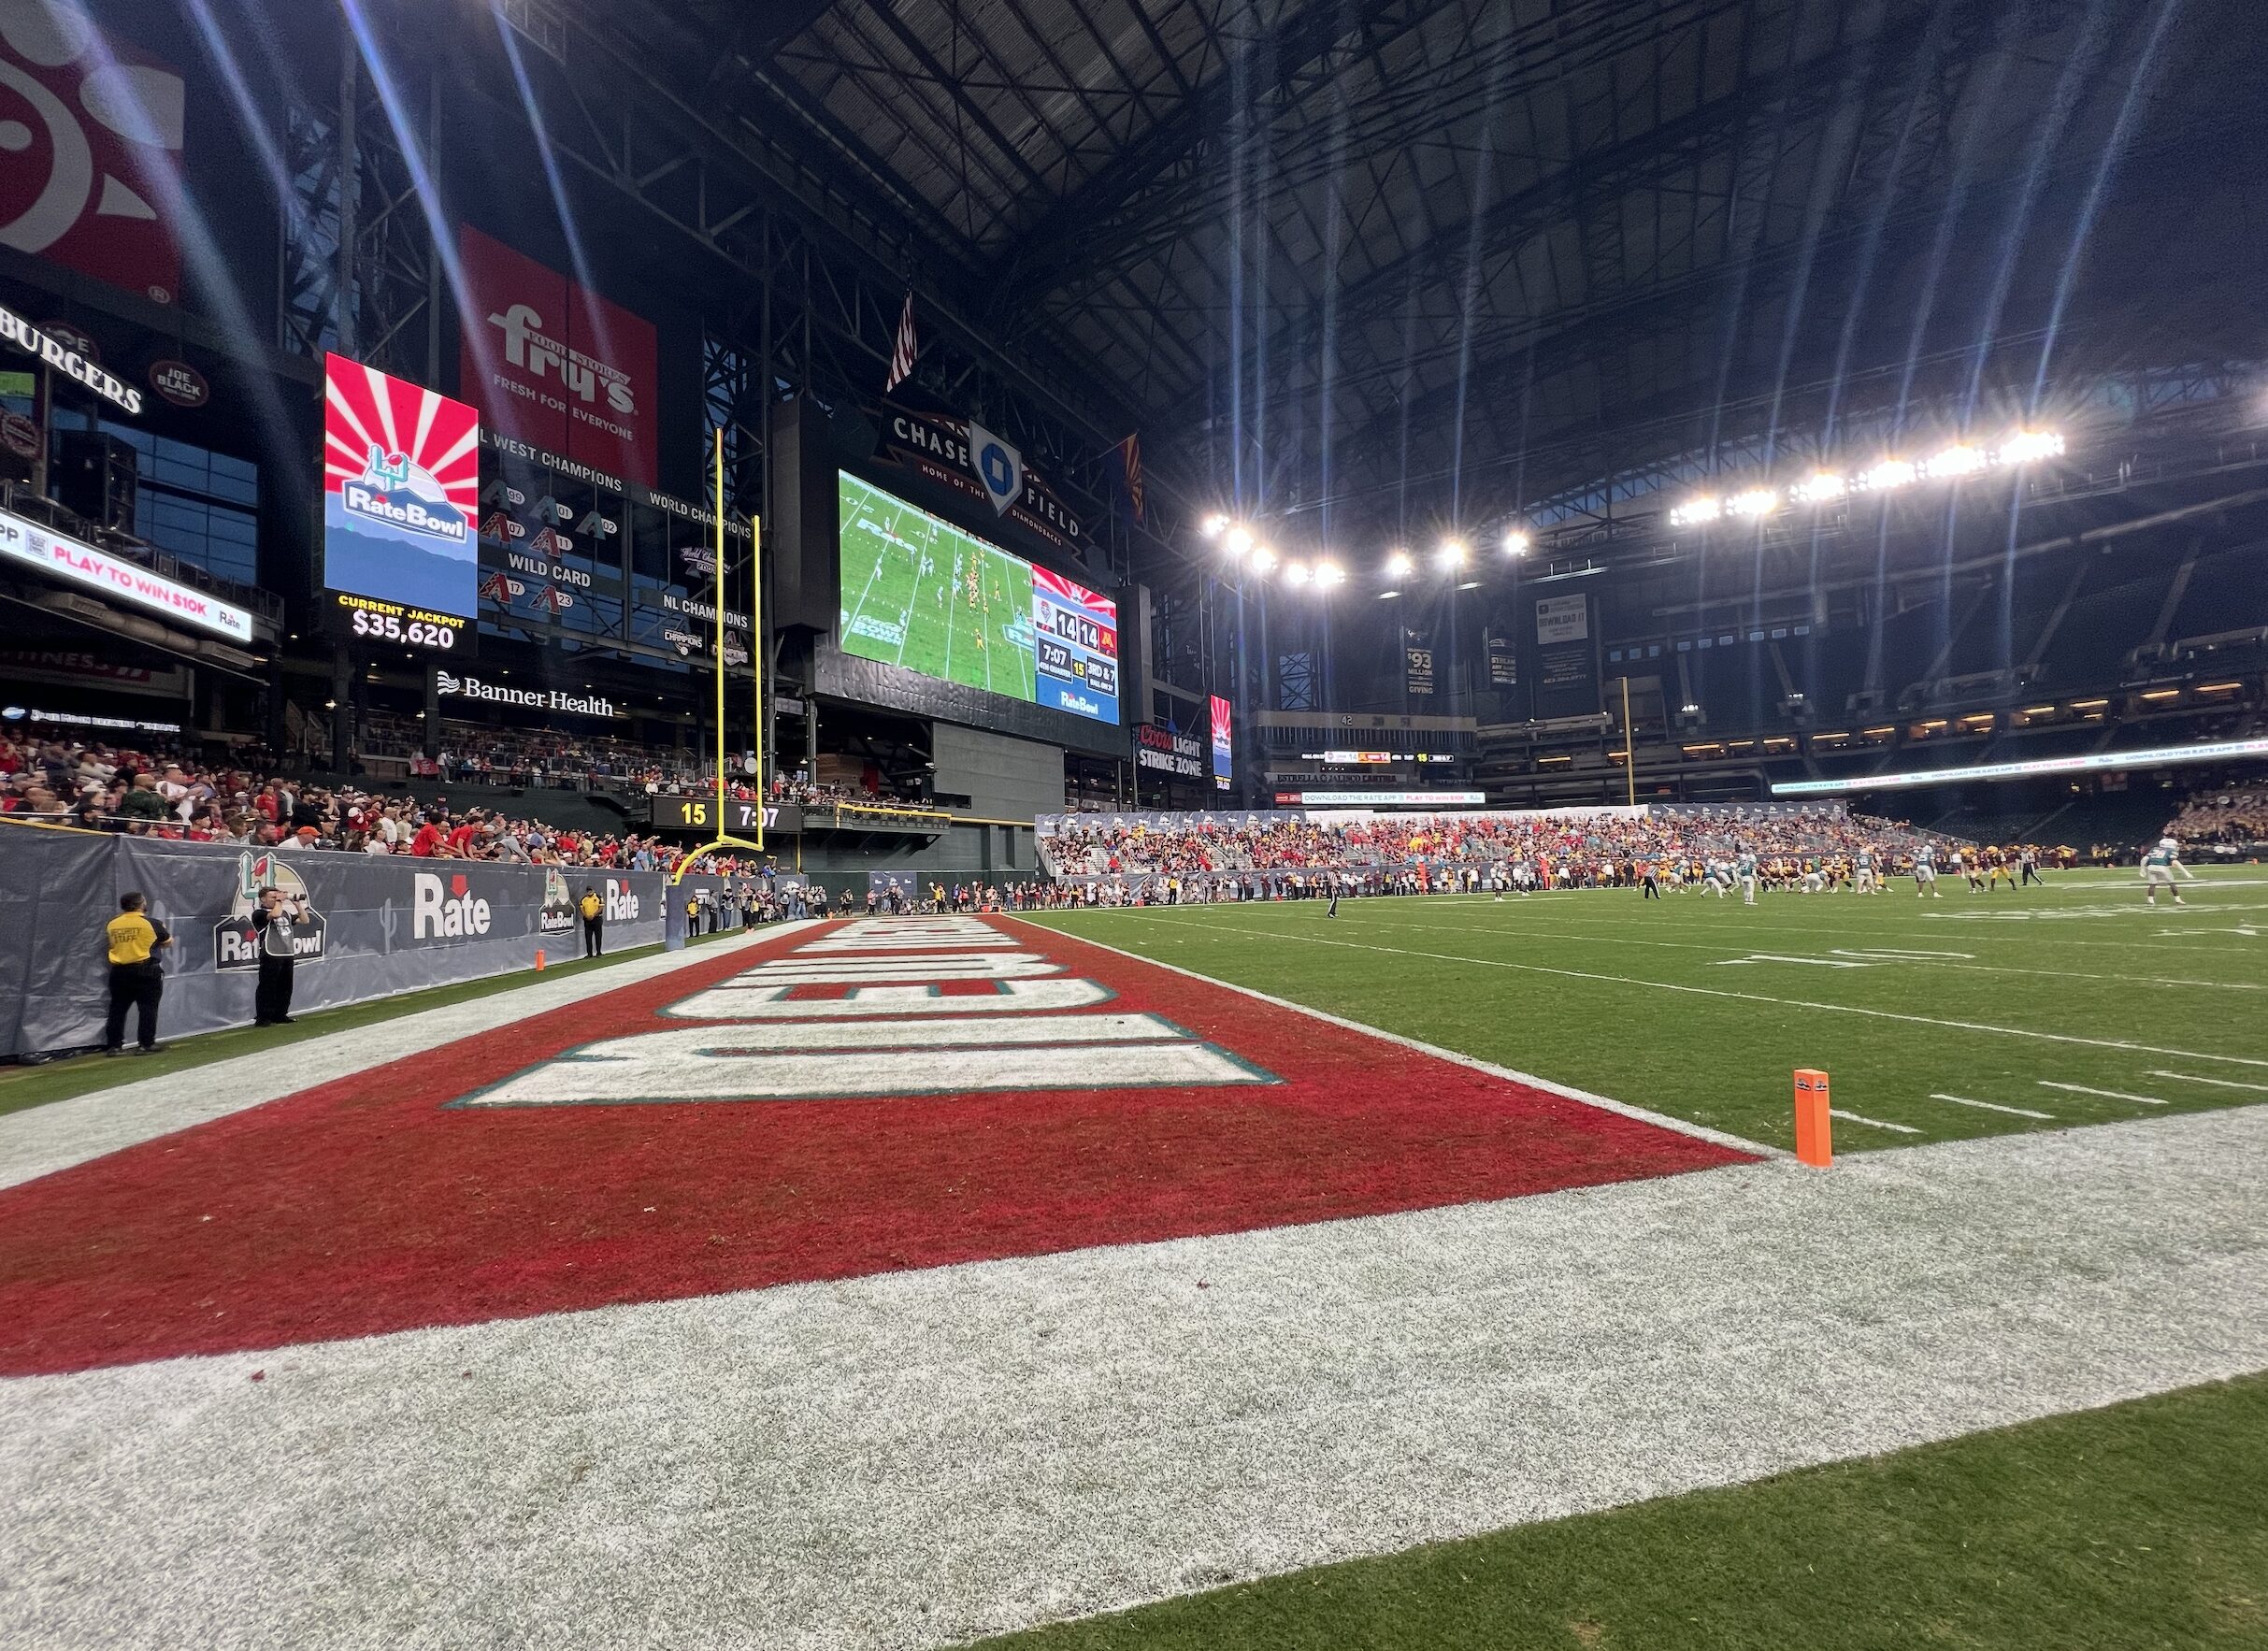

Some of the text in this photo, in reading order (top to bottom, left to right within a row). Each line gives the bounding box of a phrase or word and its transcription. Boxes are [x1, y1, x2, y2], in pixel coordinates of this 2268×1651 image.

[0, 307, 142, 414] BURGERS
[487, 304, 636, 414] fry's
[157, 374, 201, 397] BLACK
[168, 367, 191, 383] JOE
[494, 374, 634, 441] FRESH FOR EVERYONE
[494, 434, 537, 460] WEST
[541, 452, 623, 492] CHAMPIONS
[894, 417, 1079, 537] CHASE FIELD
[508, 490, 523, 502] 99
[649, 491, 688, 515] WORLD
[922, 464, 1062, 547] HOME OF THE DIAMONDBACKS
[348, 488, 464, 537] RateBowl
[509, 524, 522, 535] 07
[509, 553, 591, 587] WILD CARD
[54, 545, 104, 576] PLAY
[108, 566, 133, 588] TO
[136, 578, 170, 601] WIN
[173, 592, 208, 616] $10K
[220, 610, 241, 629] Rate
[510, 582, 520, 593] 17
[559, 595, 571, 605] 23
[338, 595, 466, 628] CURRENT JACKPOT
[663, 594, 748, 627] NL CHAMIONS
[352, 609, 454, 649] $35,620
[665, 631, 703, 648] CHAMPIONS
[1058, 613, 1077, 640] 14
[1081, 623, 1098, 648] 14
[1042, 644, 1067, 666] 7:07
[1073, 662, 1084, 676] 15
[1407, 652, 1432, 669] $93
[1087, 662, 1115, 682] 3RD & 7
[464, 677, 614, 717] Banner Health
[1341, 715, 1353, 725] 42
[1172, 736, 1201, 757] LIGHT
[1139, 748, 1202, 777] STRIKE ZONE
[1277, 774, 1319, 783] ESTRELLA
[1327, 774, 1360, 783] JALISCO
[681, 802, 780, 828] 15 7:07
[414, 872, 491, 940] Rate
[540, 912, 575, 930] RateBowl
[606, 879, 640, 921] Rate
[221, 930, 322, 962] Ratowl
